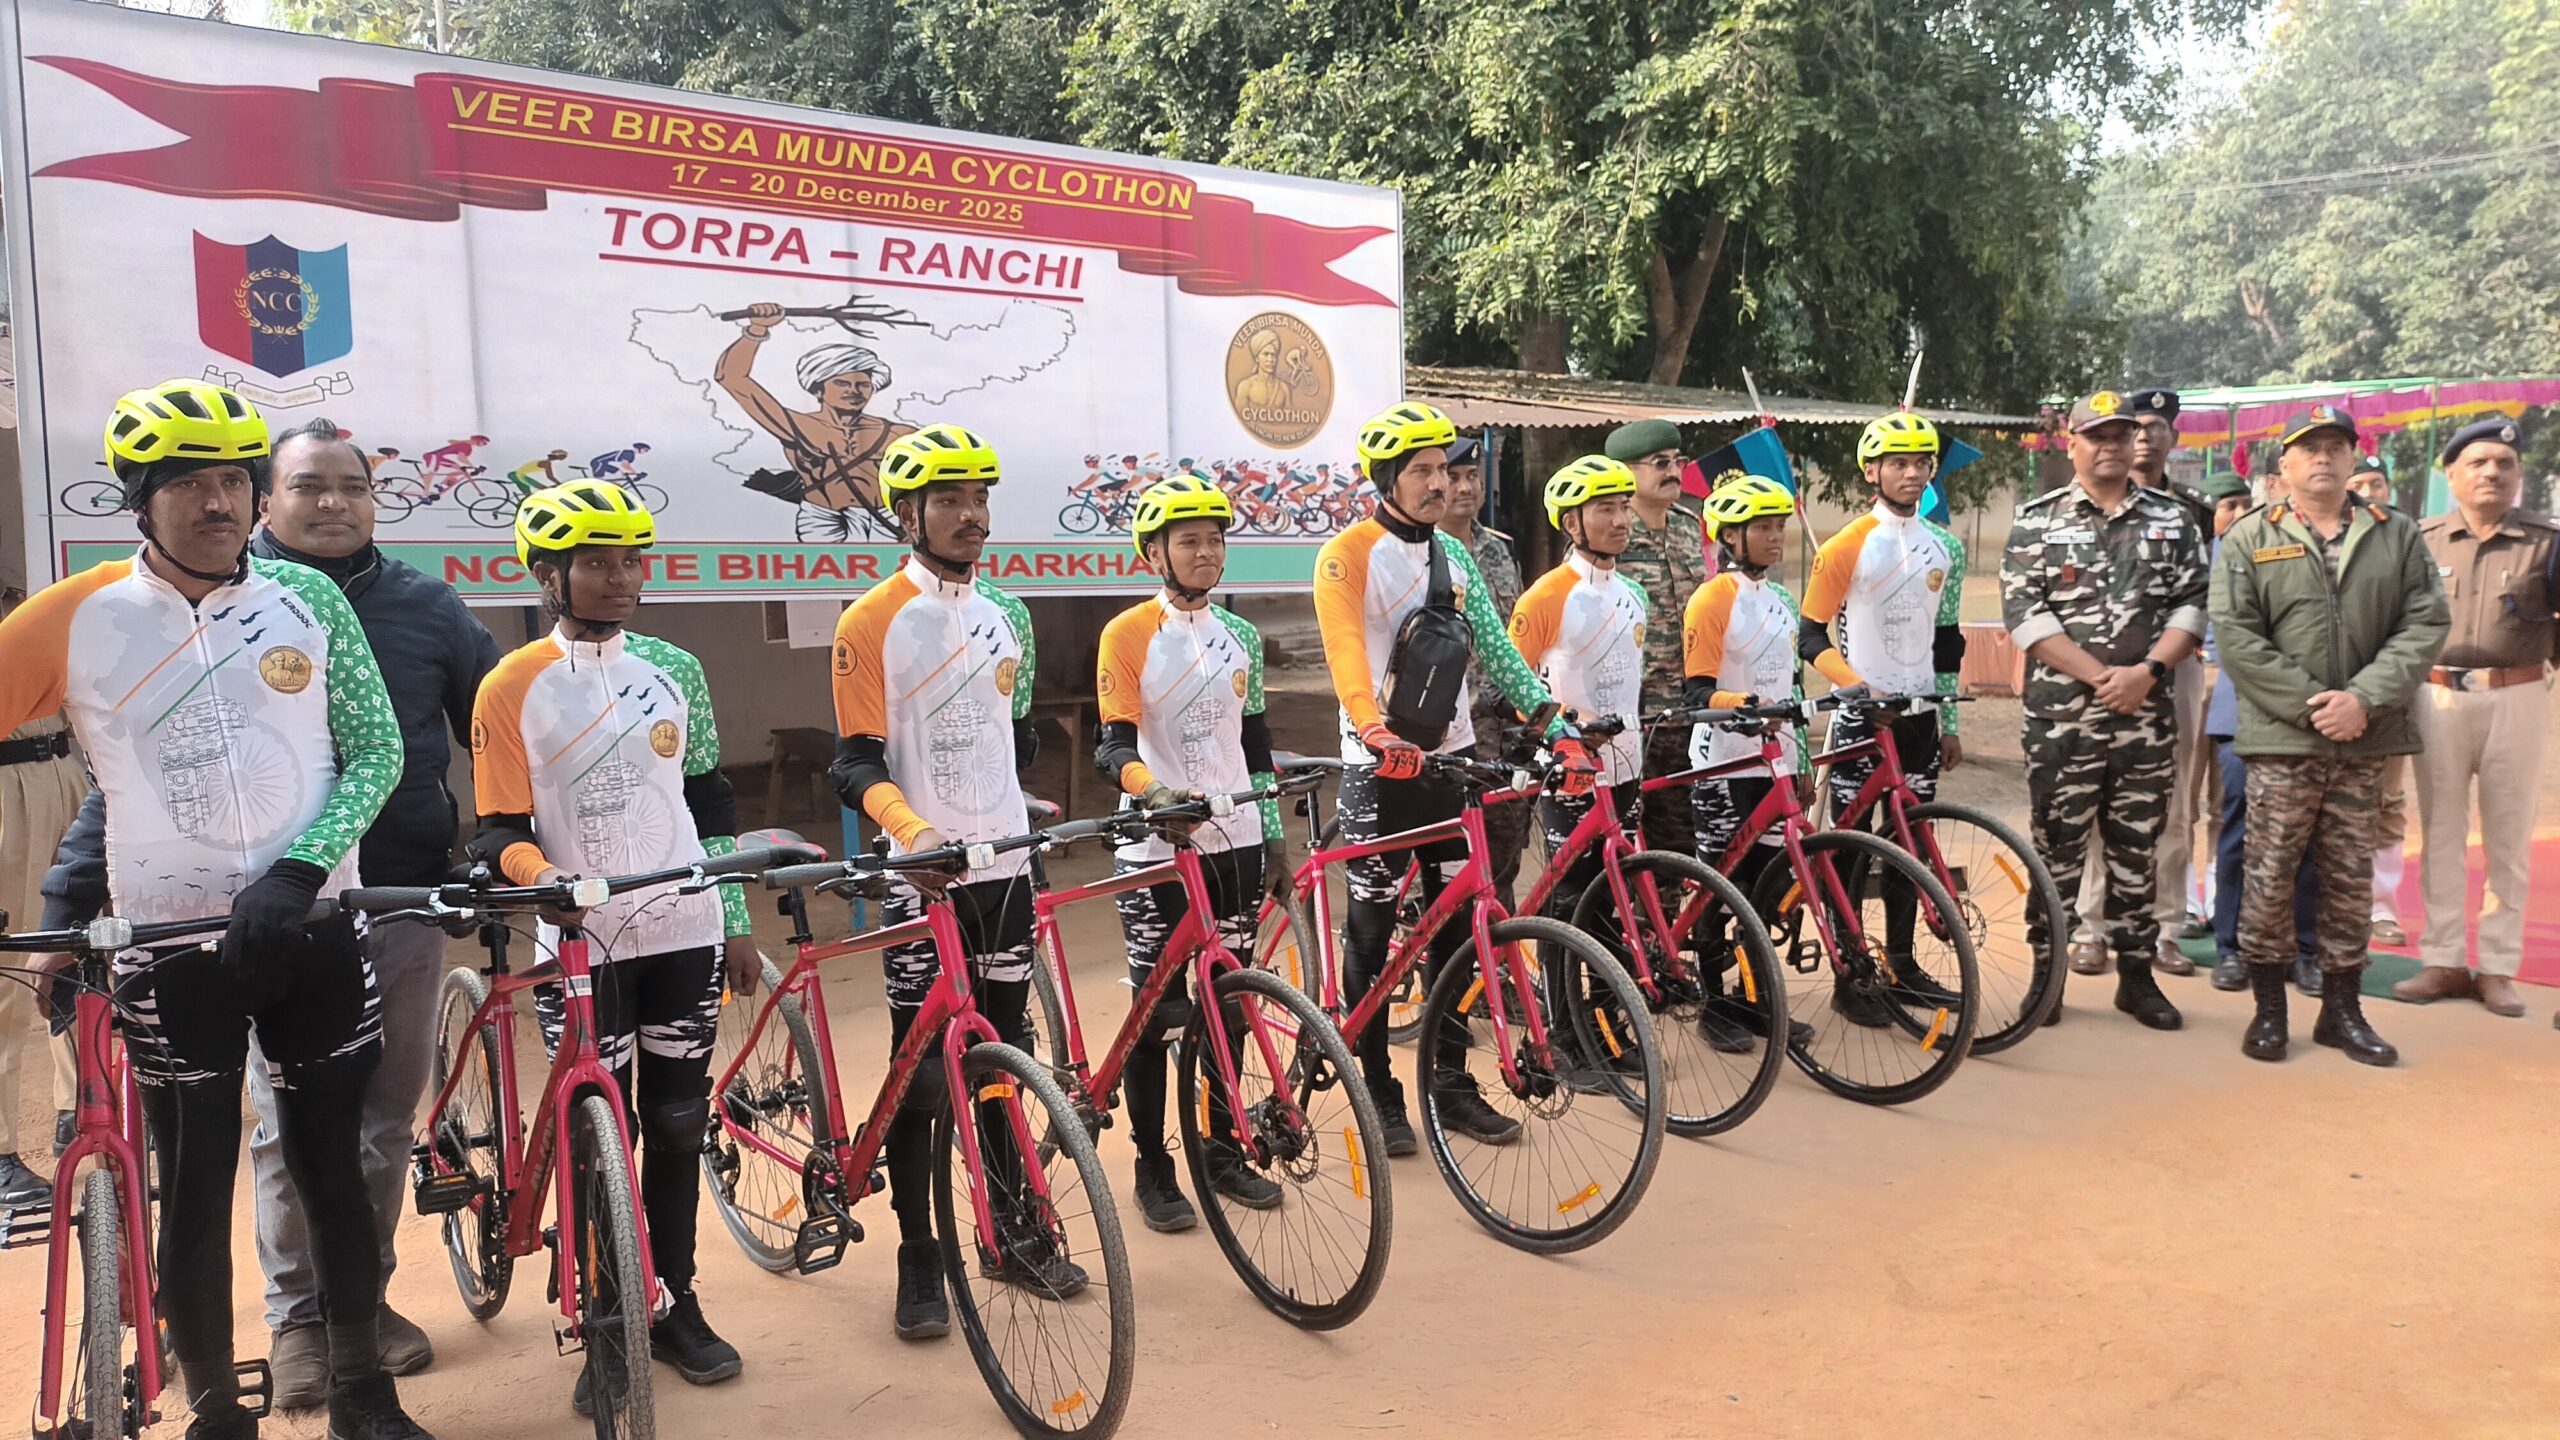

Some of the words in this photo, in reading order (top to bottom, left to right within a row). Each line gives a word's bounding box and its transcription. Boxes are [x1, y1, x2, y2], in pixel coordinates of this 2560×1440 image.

[450, 86, 593, 134] VEER
[611, 110, 761, 157] BIRSA
[776, 132, 938, 180] MUNDA
[950, 156, 1194, 211] CYCLOTHON
[671, 163, 706, 184] 17
[750, 172, 786, 195] 20
[797, 178, 951, 214] December
[959, 196, 1024, 222] 2025
[604, 206, 811, 265] TORPA
[878, 237, 1084, 290] RANCHI
[252, 290, 302, 313] NCC
[1234, 320, 1258, 349] VEER
[1259, 314, 1290, 329] BIRSA
[1291, 320, 1325, 358] MUNDA
[1241, 406, 1320, 424] CYCLOTHON
[443, 555, 526, 584] NC
[642, 553, 701, 581] TE
[717, 553, 882, 581] BIHAR
[974, 553, 1164, 579] HARKHA
[279, 596, 314, 630] AERODOC
